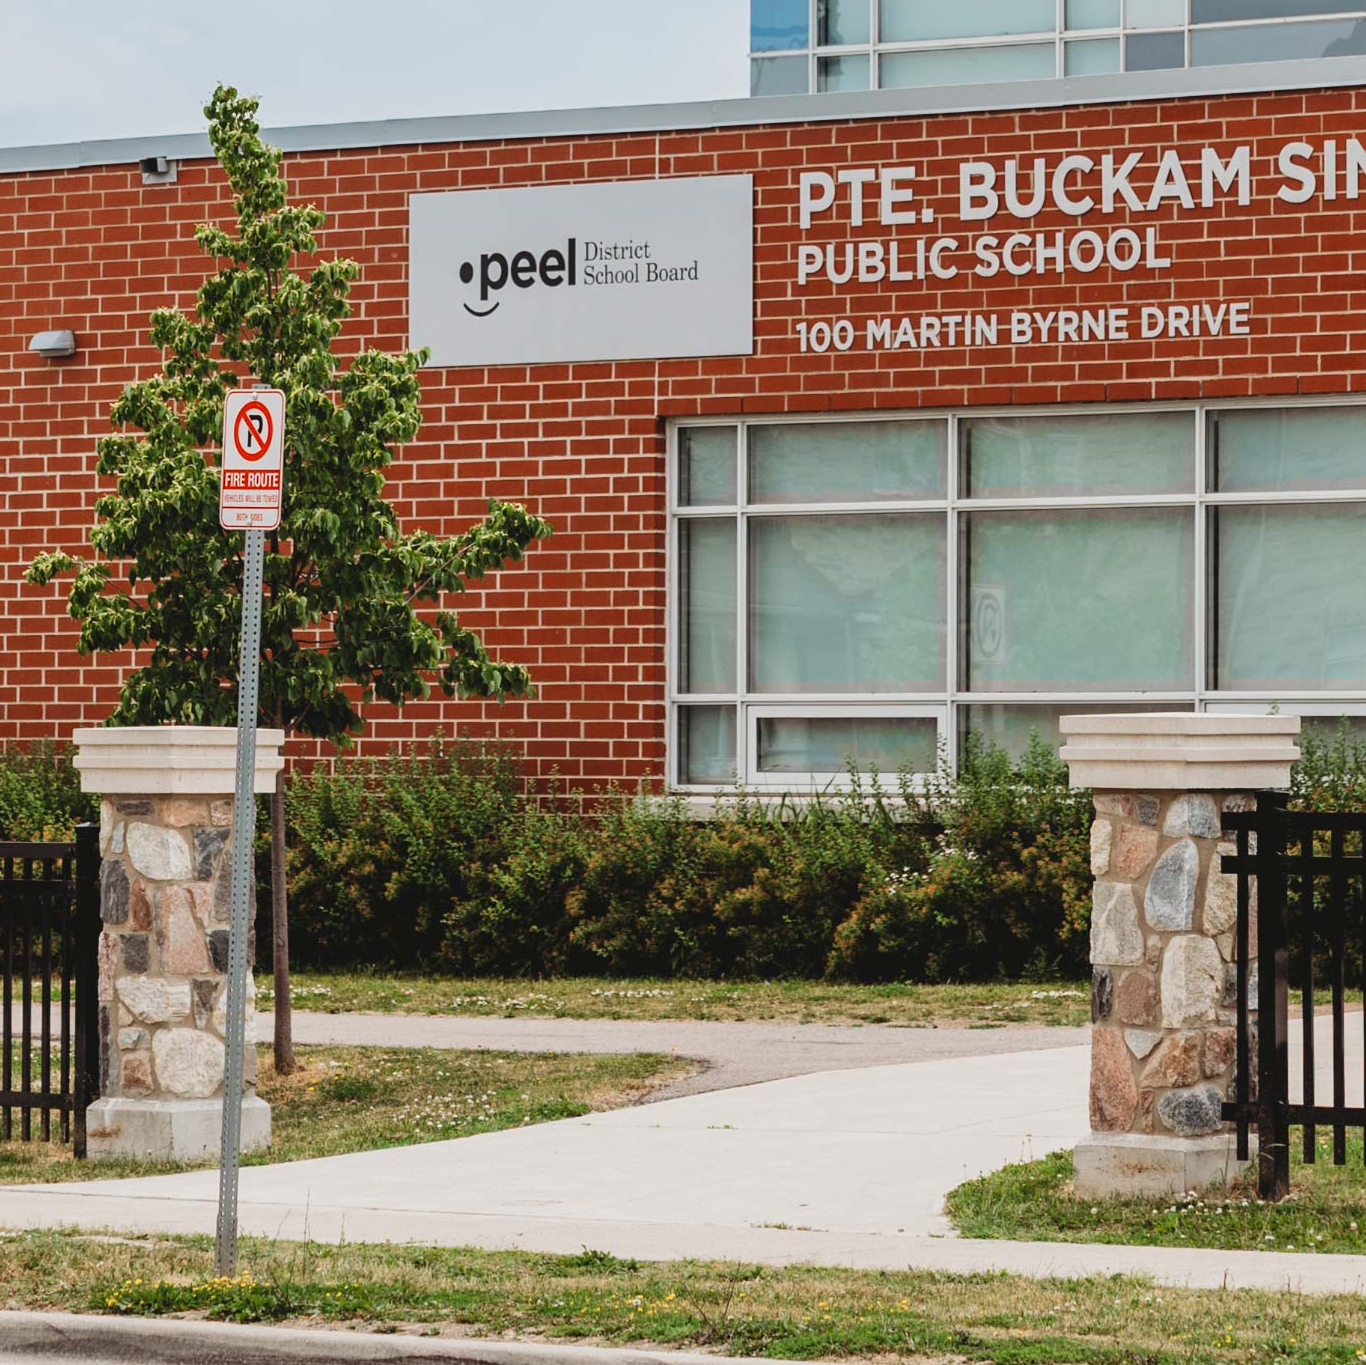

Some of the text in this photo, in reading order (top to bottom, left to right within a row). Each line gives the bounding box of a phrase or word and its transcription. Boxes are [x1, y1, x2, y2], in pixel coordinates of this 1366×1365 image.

[799, 166, 934, 230] PTE.
[959, 146, 1252, 222] BUCKAM
[480, 237, 577, 302] peel
[583, 239, 652, 262] District
[583, 260, 700, 286] School Board
[797, 227, 1172, 286] PUBLIC SCHOOL
[795, 301, 1251, 354] 100 MARTIN BYRNE DRIVE
[225, 472, 279, 488] FIRE ROUTE
